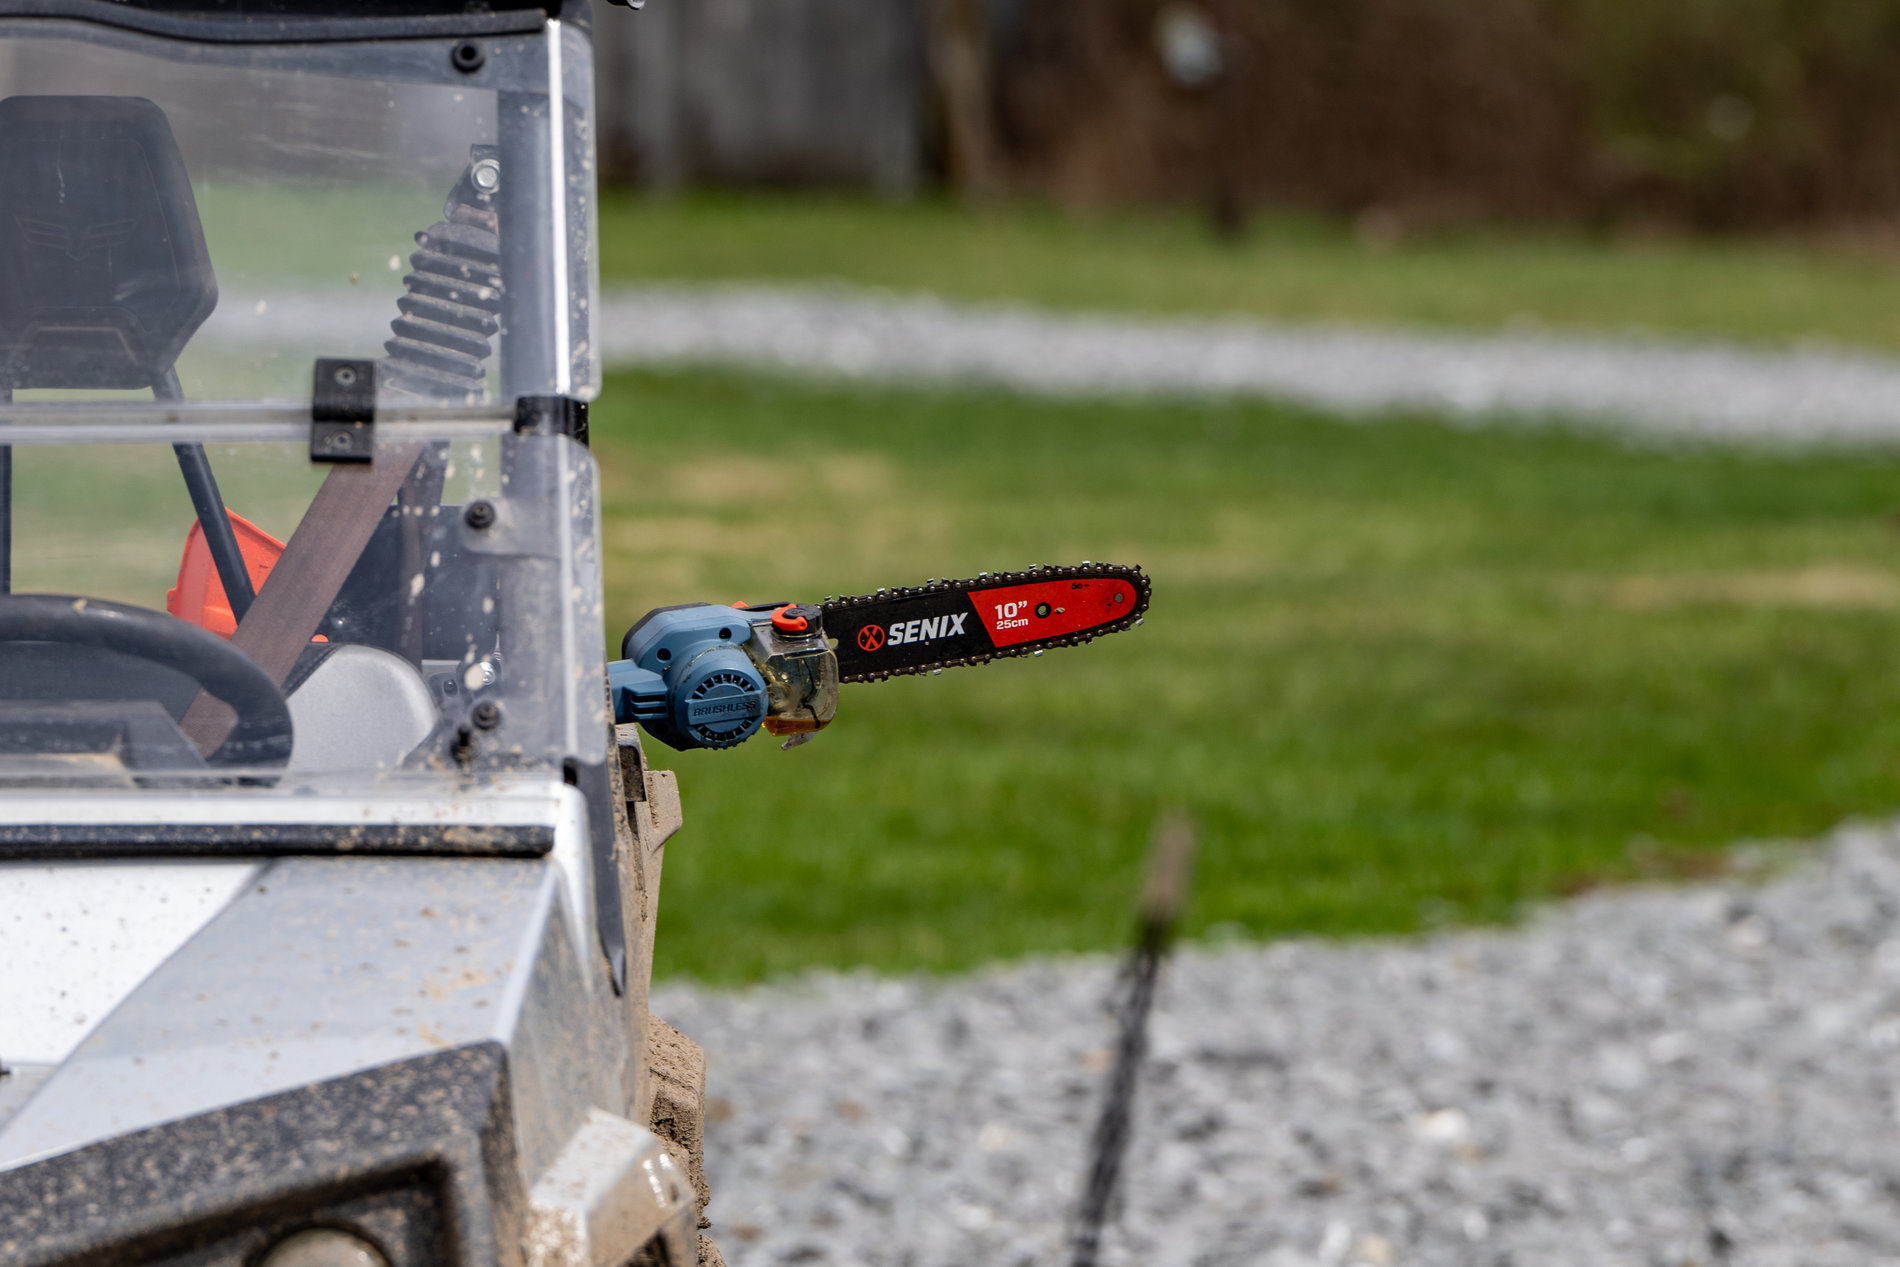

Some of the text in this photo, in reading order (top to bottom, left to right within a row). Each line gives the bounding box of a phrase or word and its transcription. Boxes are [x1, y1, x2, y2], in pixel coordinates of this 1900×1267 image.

[887, 612, 968, 646] SENIX
[996, 618, 1029, 630] 25cm
[693, 701, 757, 716] BRUSHLESS
